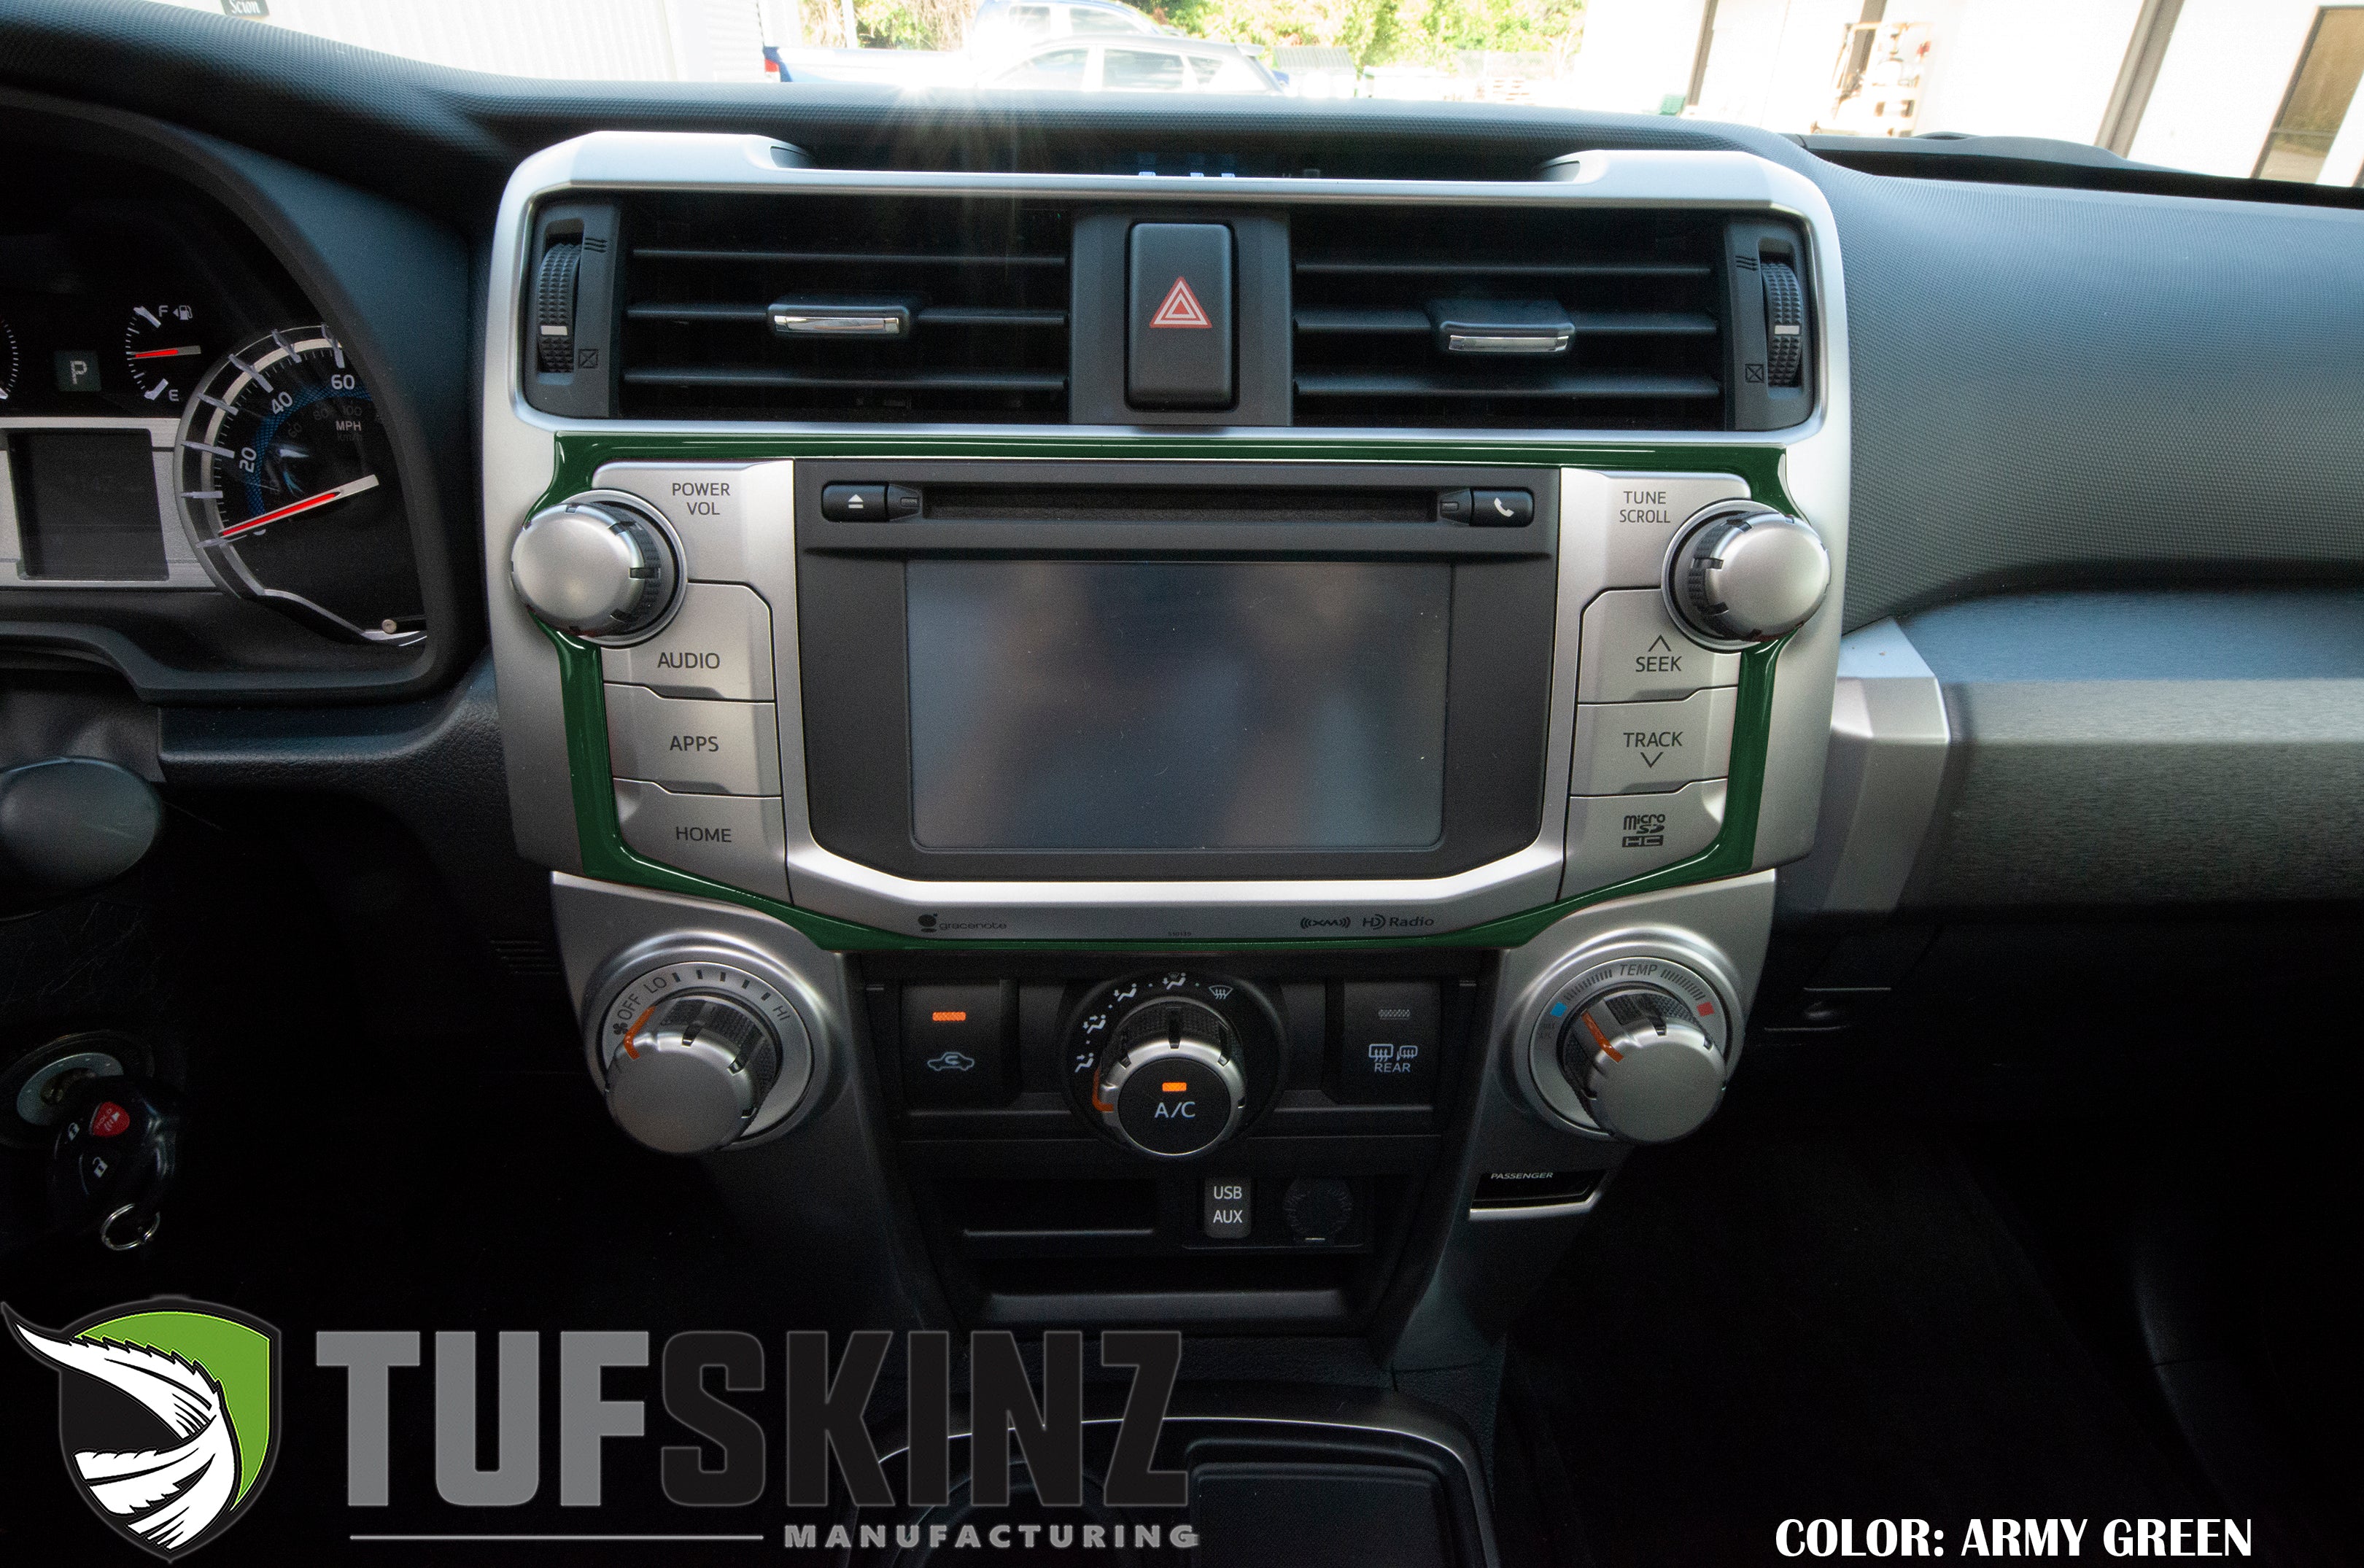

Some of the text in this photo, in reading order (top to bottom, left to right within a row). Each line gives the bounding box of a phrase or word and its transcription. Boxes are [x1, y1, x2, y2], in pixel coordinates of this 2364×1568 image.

[158, 306, 168, 317] F
[70, 360, 87, 384] P
[331, 374, 354, 389] 60
[168, 389, 179, 402] E
[271, 391, 292, 414] 40
[313, 408, 329, 421] 80
[342, 405, 363, 416] 100
[287, 422, 302, 438] 60
[336, 420, 362, 431] MPH
[239, 447, 257, 473] 20
[672, 482, 730, 497] POWER
[1624, 491, 1667, 505] TUNE
[686, 502, 720, 516] VOL
[1619, 509, 1670, 524] SCROLL
[657, 652, 720, 669] AUDIO
[1635, 656, 1681, 672] SEEK
[670, 736, 719, 752] APPS
[1623, 731, 1683, 748] TRACK
[1623, 814, 1665, 830] micro
[675, 826, 732, 842] HOME
[939, 923, 1007, 931] gracenote
[1363, 914, 1434, 929] HD Radio
[1619, 963, 1657, 977] TEMP
[643, 977, 667, 994] LO
[617, 993, 641, 1020] OFF
[772, 1005, 790, 1020] HI
[1374, 1063, 1411, 1073] REAR
[1154, 1101, 1196, 1119] A/C
[1491, 1171, 1554, 1180] PASSENGER
[1213, 1187, 1242, 1200] USB
[1212, 1211, 1243, 1224] AUX
